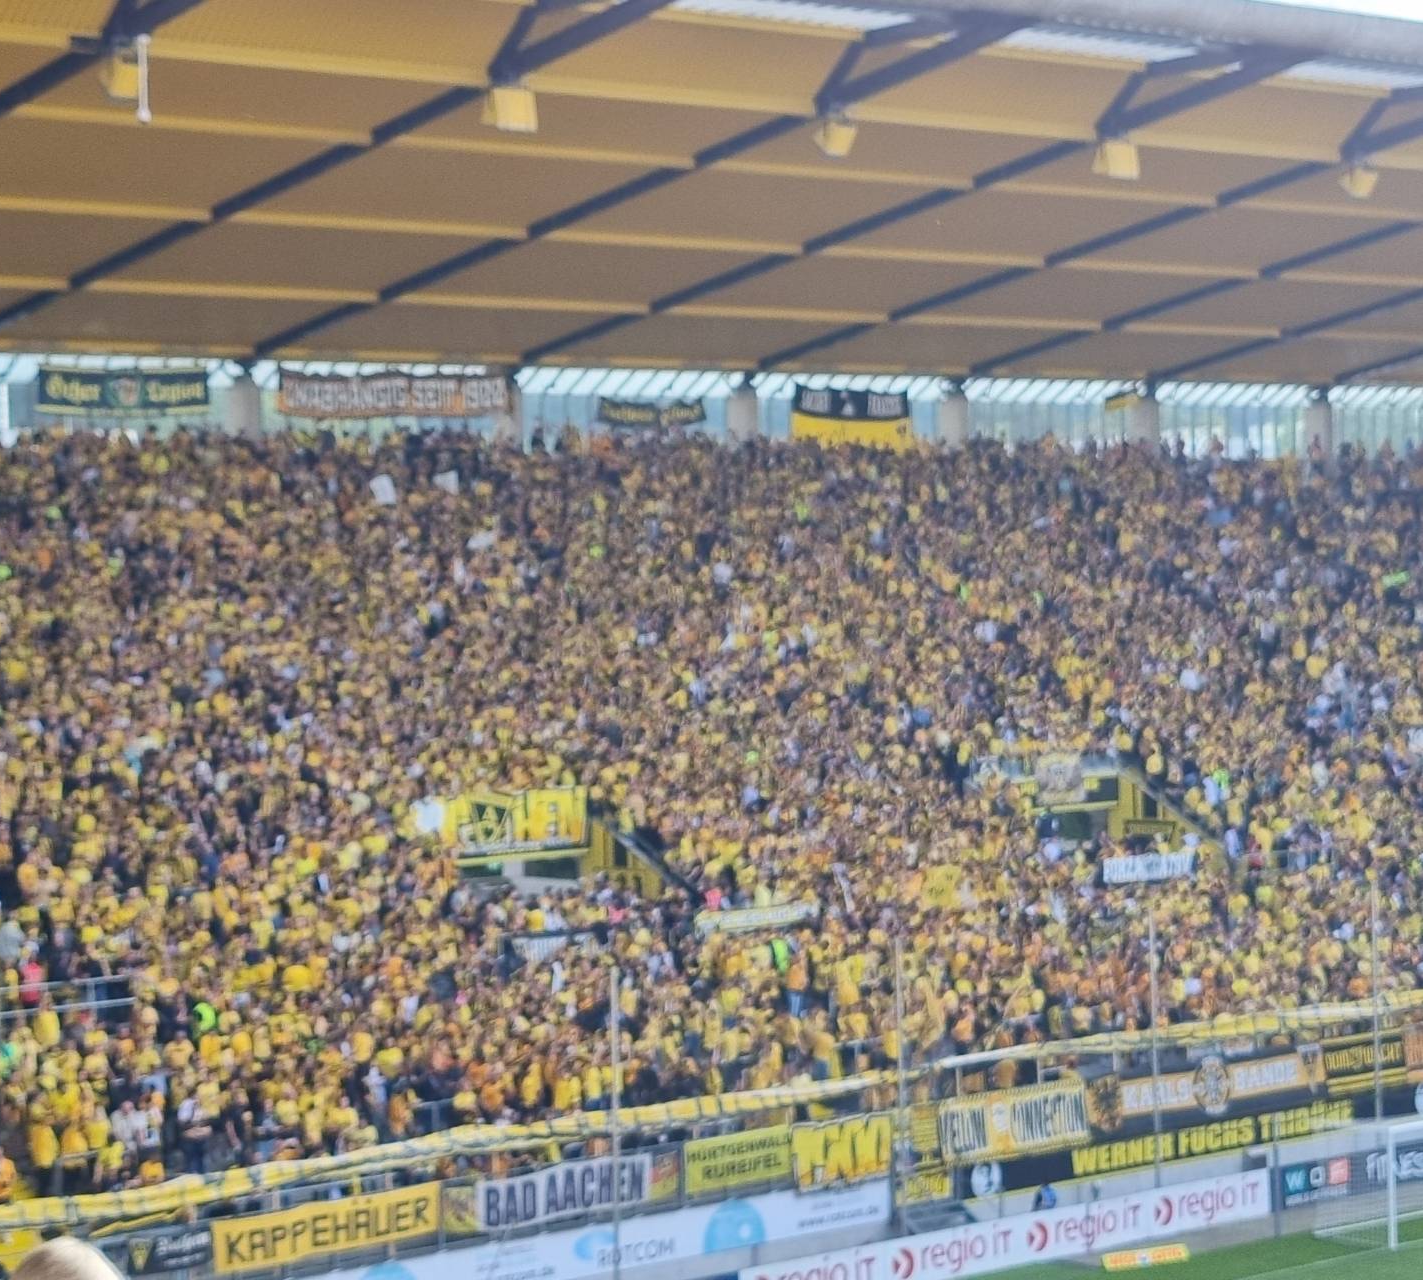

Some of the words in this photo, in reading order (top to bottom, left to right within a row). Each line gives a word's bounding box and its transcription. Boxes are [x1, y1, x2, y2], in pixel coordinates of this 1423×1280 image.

[1072, 1134, 1174, 1175] WERNER
[1178, 1116, 1255, 1156] FUCHS
[486, 1180, 537, 1227] BAD
[544, 1160, 644, 1215] AACHEN
[1178, 1178, 1235, 1220] regio
[225, 1197, 430, 1264] KAPPEHÄUER
[920, 1227, 986, 1273] regio
[1055, 1203, 1117, 1247] regio
